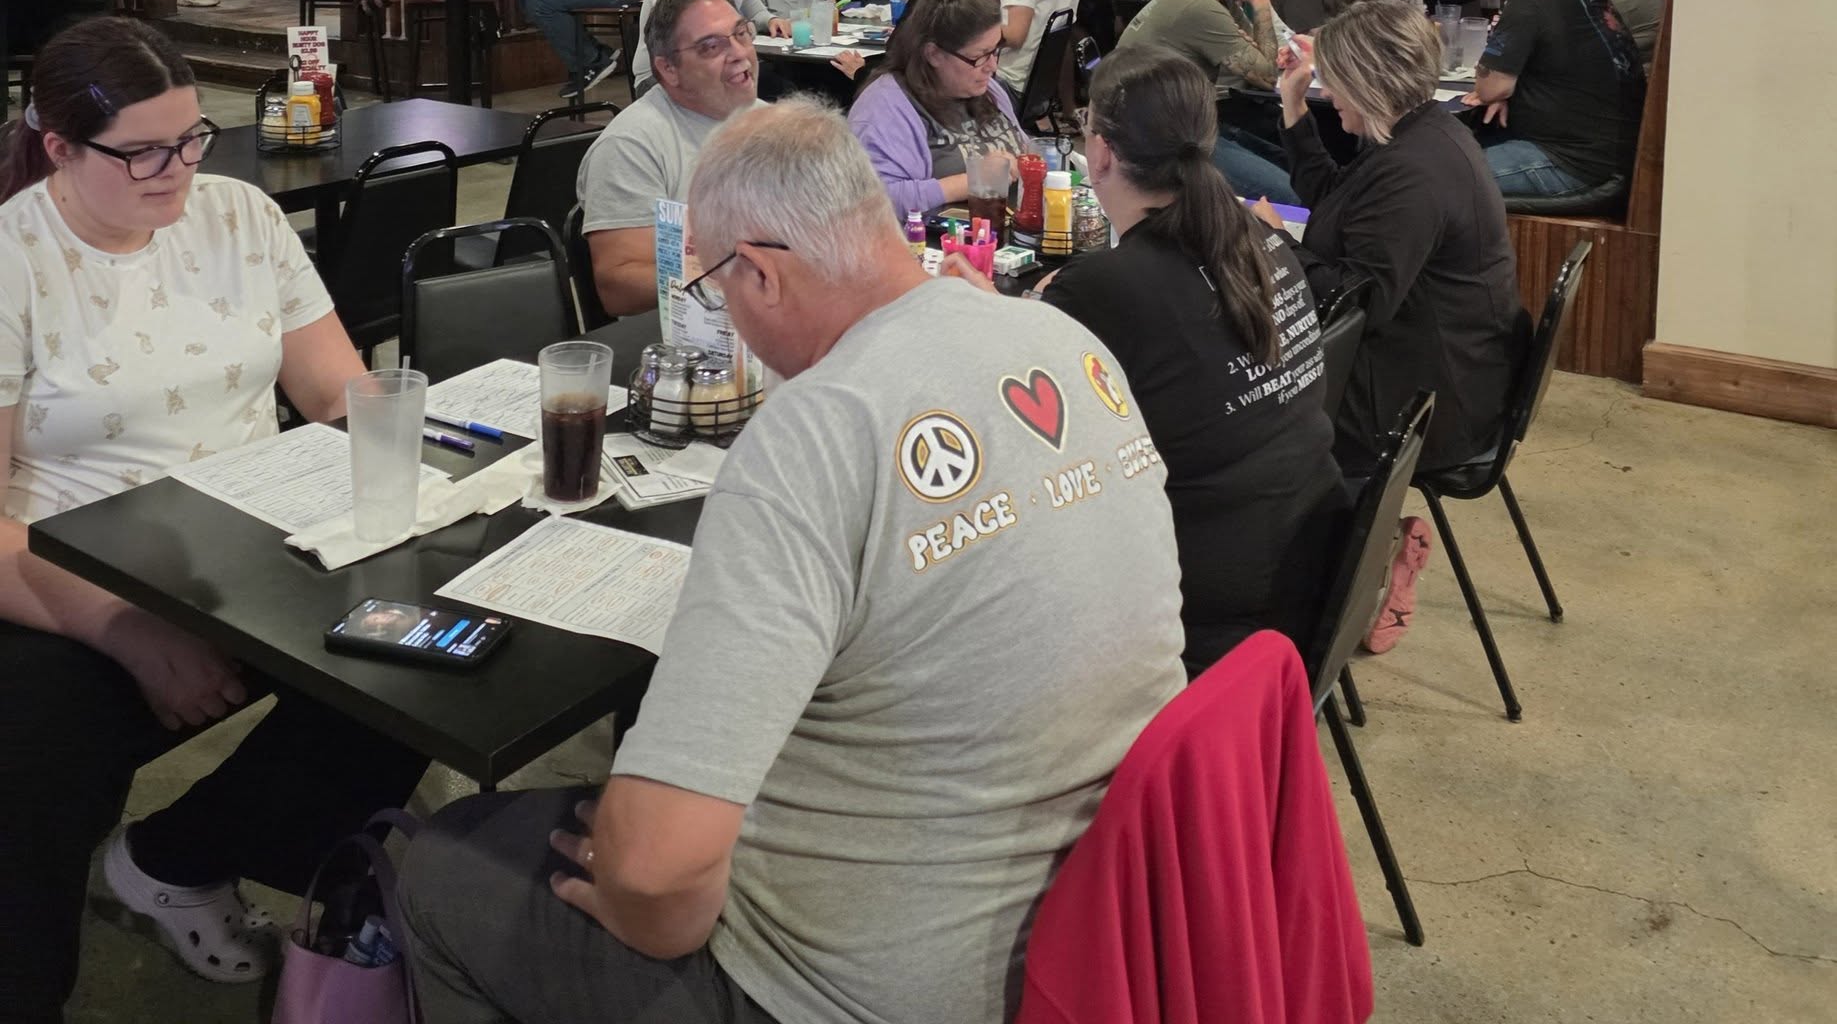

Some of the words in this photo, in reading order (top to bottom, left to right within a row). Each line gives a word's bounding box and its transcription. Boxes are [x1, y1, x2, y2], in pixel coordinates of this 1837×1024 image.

[1272, 309, 1286, 325] NO
[1227, 362, 1239, 375] 2.
[1225, 402, 1237, 415] 3.
[1238, 386, 1262, 407] Will
[1262, 370, 1292, 396] BEAT
[908, 490, 1018, 573] PEACE
[1043, 460, 1102, 508] LOVE
